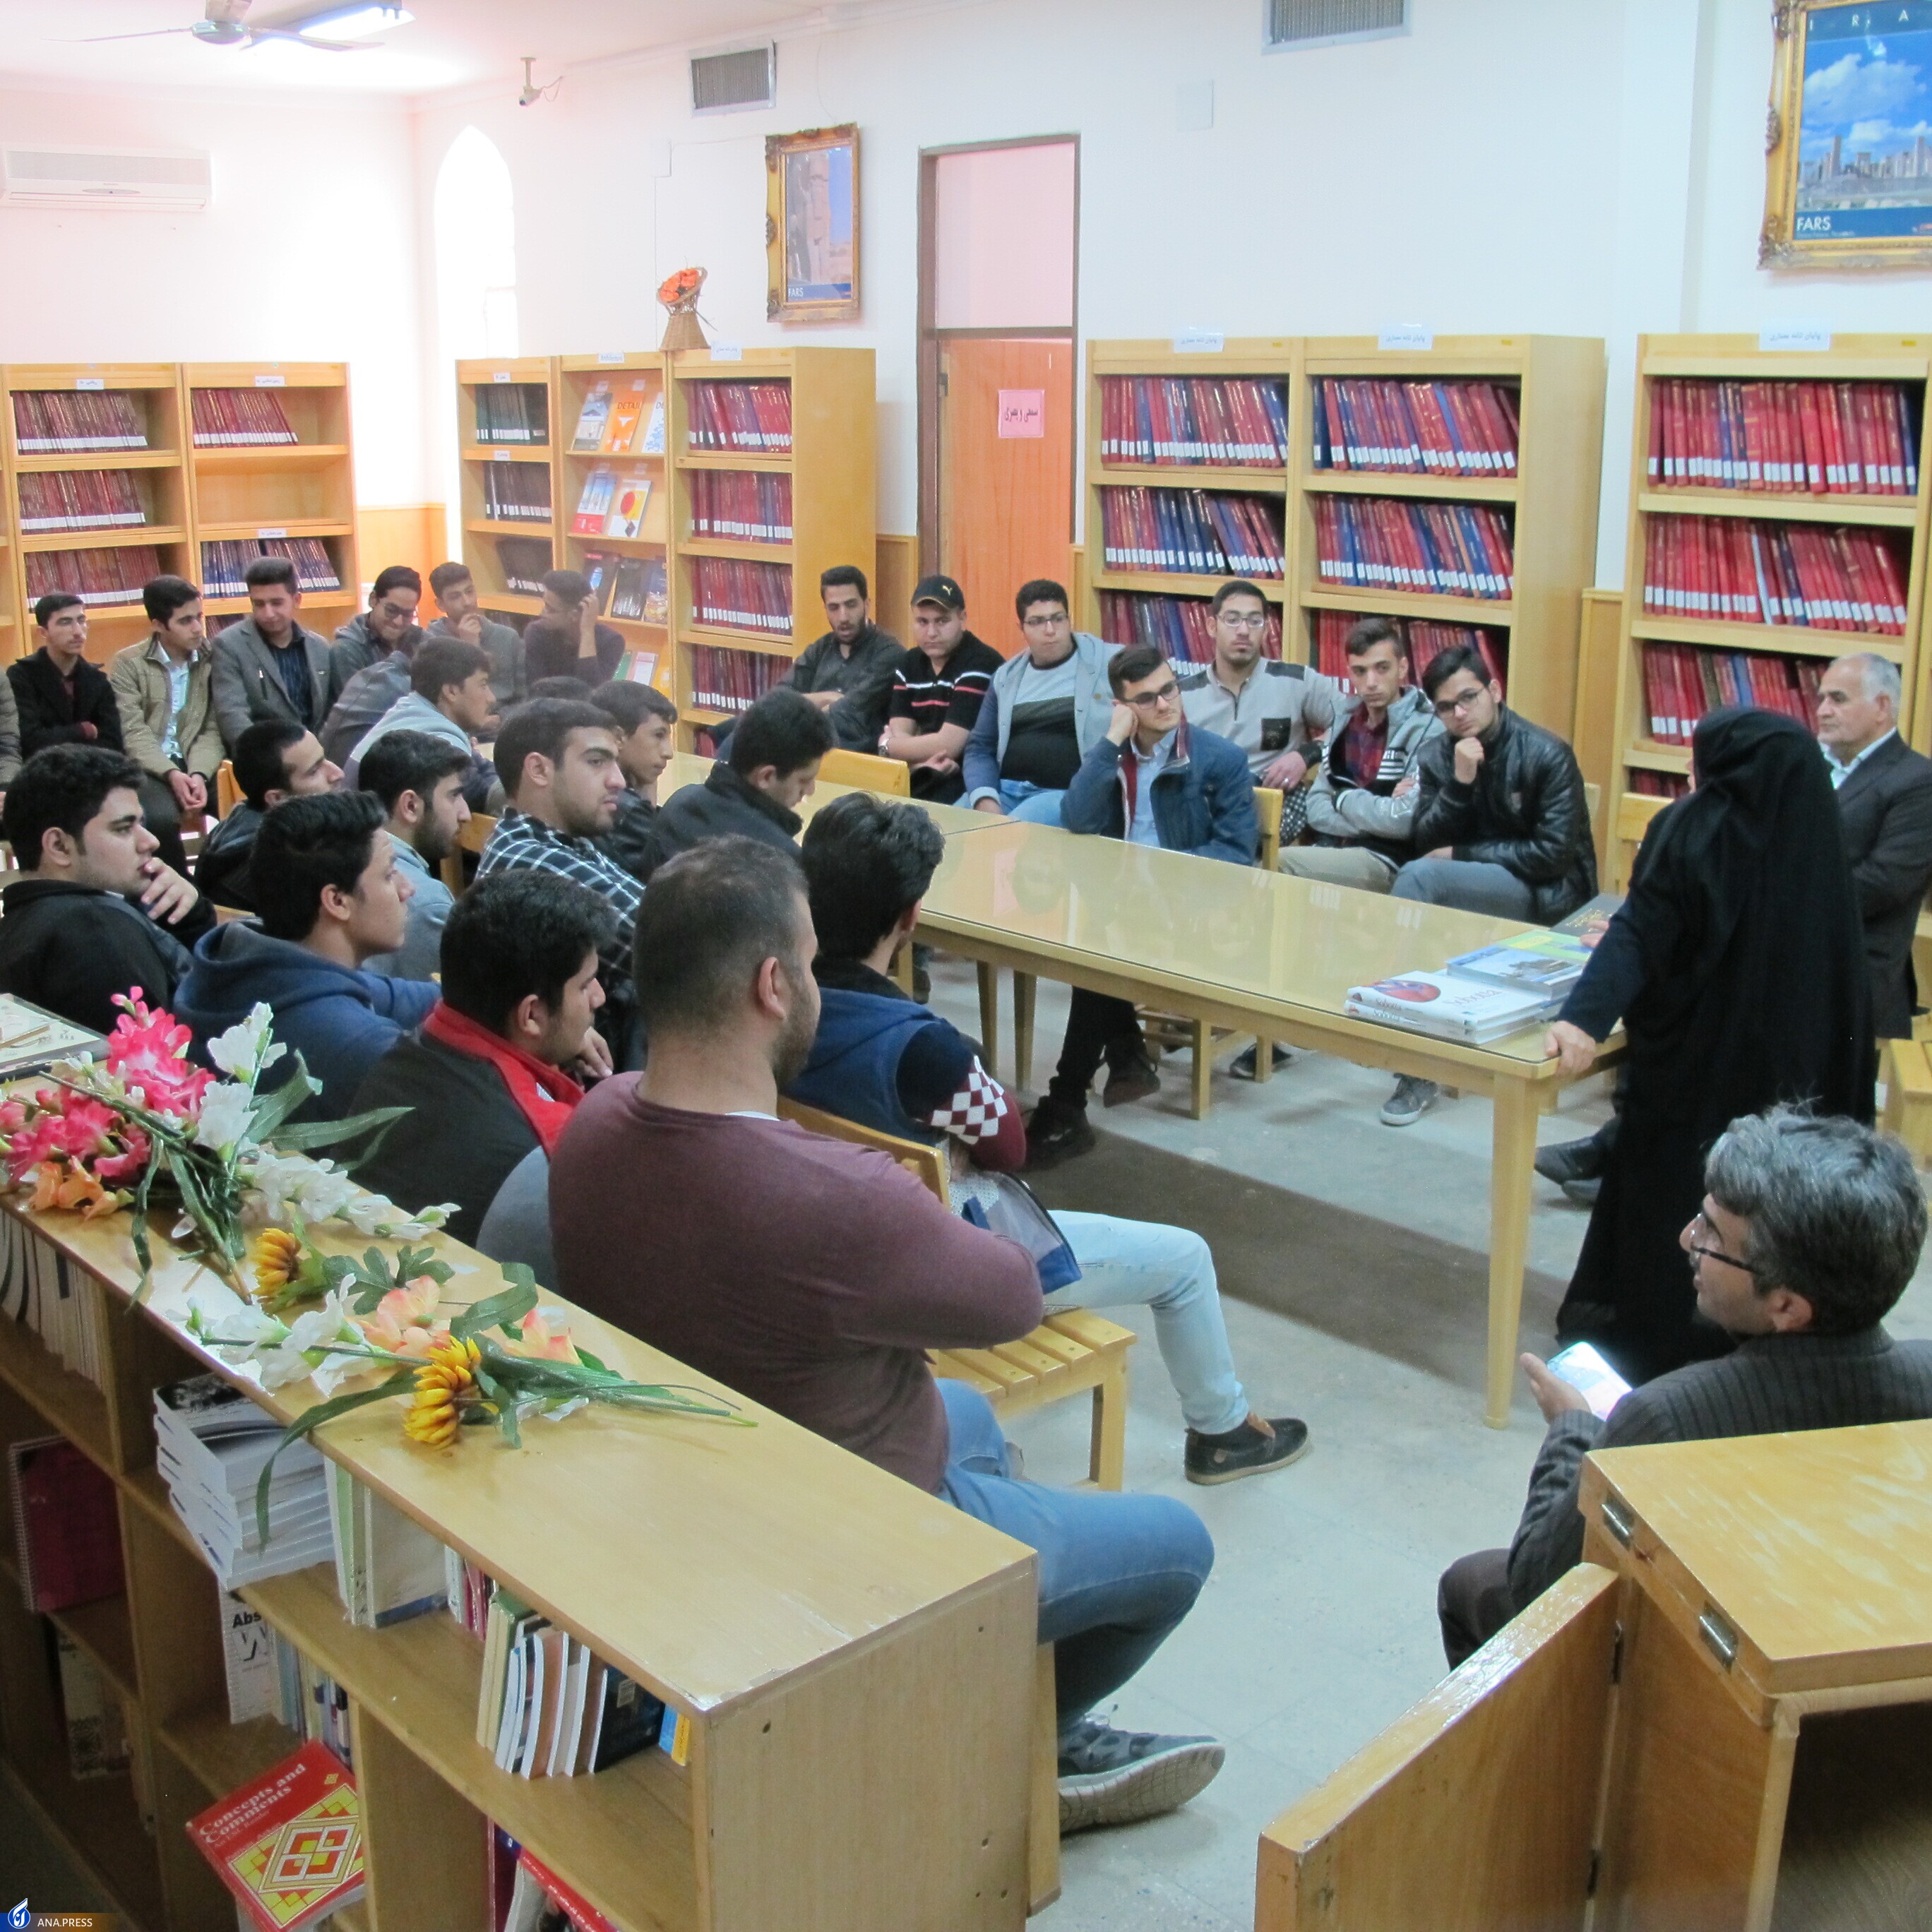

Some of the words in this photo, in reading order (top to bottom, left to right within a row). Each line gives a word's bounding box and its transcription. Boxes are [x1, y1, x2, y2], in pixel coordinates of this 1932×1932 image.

[1796, 215, 1831, 232] FARS
[233, 1611, 262, 1629] Abs
[199, 1787, 273, 1835] Concepts
[277, 1763, 306, 1787] and
[205, 1787, 292, 1843] Comments
